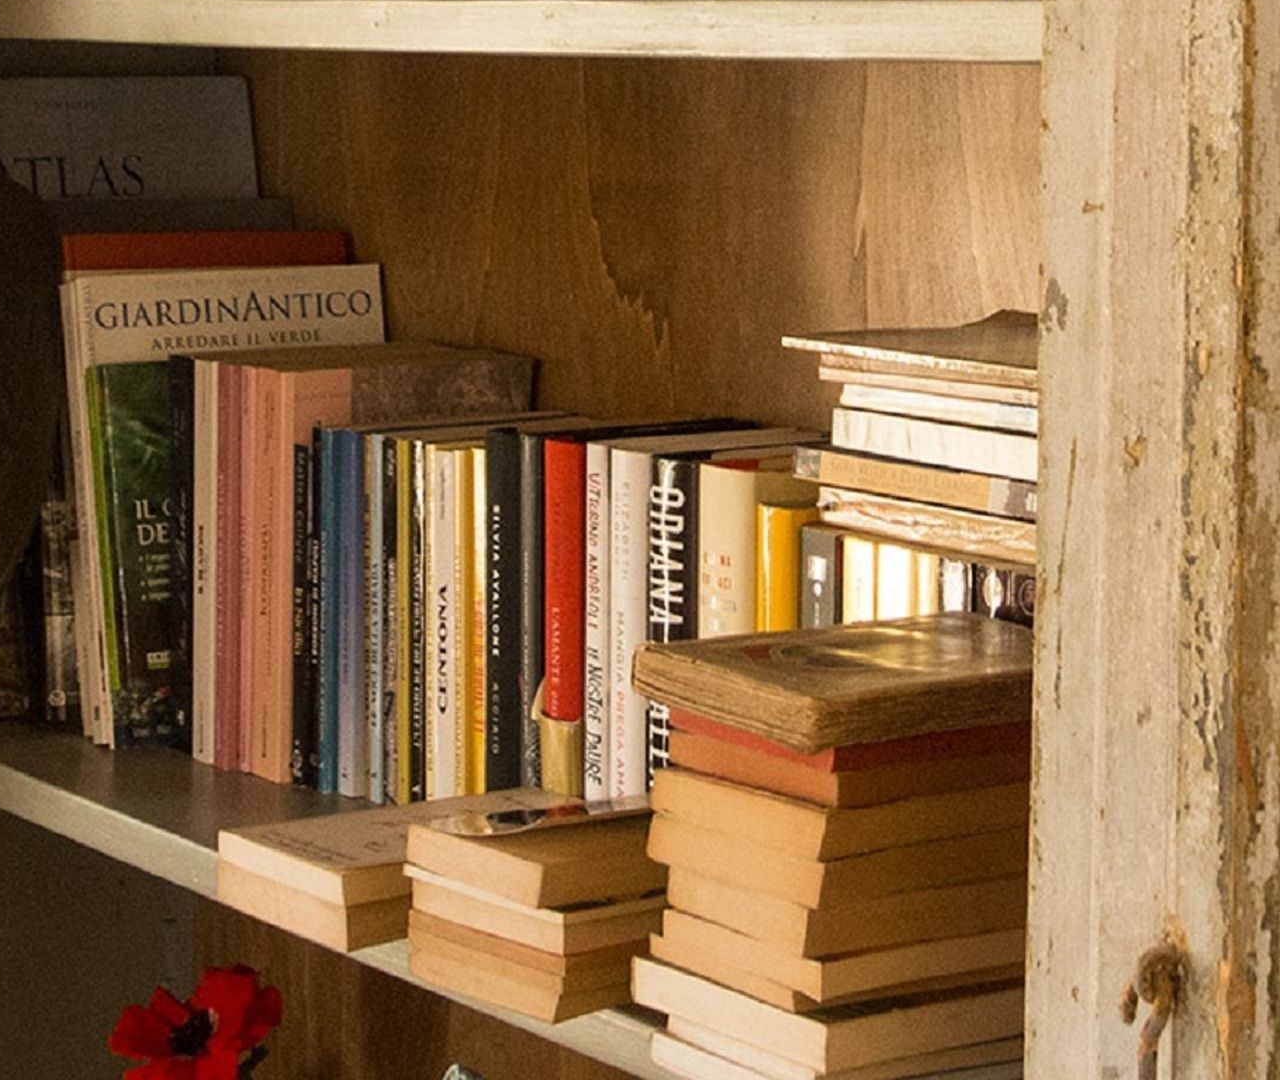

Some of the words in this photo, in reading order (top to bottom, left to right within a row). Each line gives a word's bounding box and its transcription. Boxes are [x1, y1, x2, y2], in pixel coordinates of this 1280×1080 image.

[93, 289, 373, 331] GIARDINANTICO
[150, 332, 239, 352] ARREDARE
[246, 330, 262, 347] IL
[268, 328, 322, 348] VERDE
[134, 500, 156, 521] IL
[491, 504, 502, 562] SILVIA
[621, 480, 632, 581] ELIZABETH
[648, 484, 686, 626] ORIANA
[491, 568, 502, 657] AVALLONE
[550, 606, 562, 687] L'AMANTE
[435, 584, 449, 715] CENTONA
[616, 611, 625, 685] MANGIA
[491, 681, 501, 756] ACCIAIO
[616, 690, 626, 752] PREGA
[582, 730, 603, 787] PAURE
[616, 757, 627, 797] AMA
